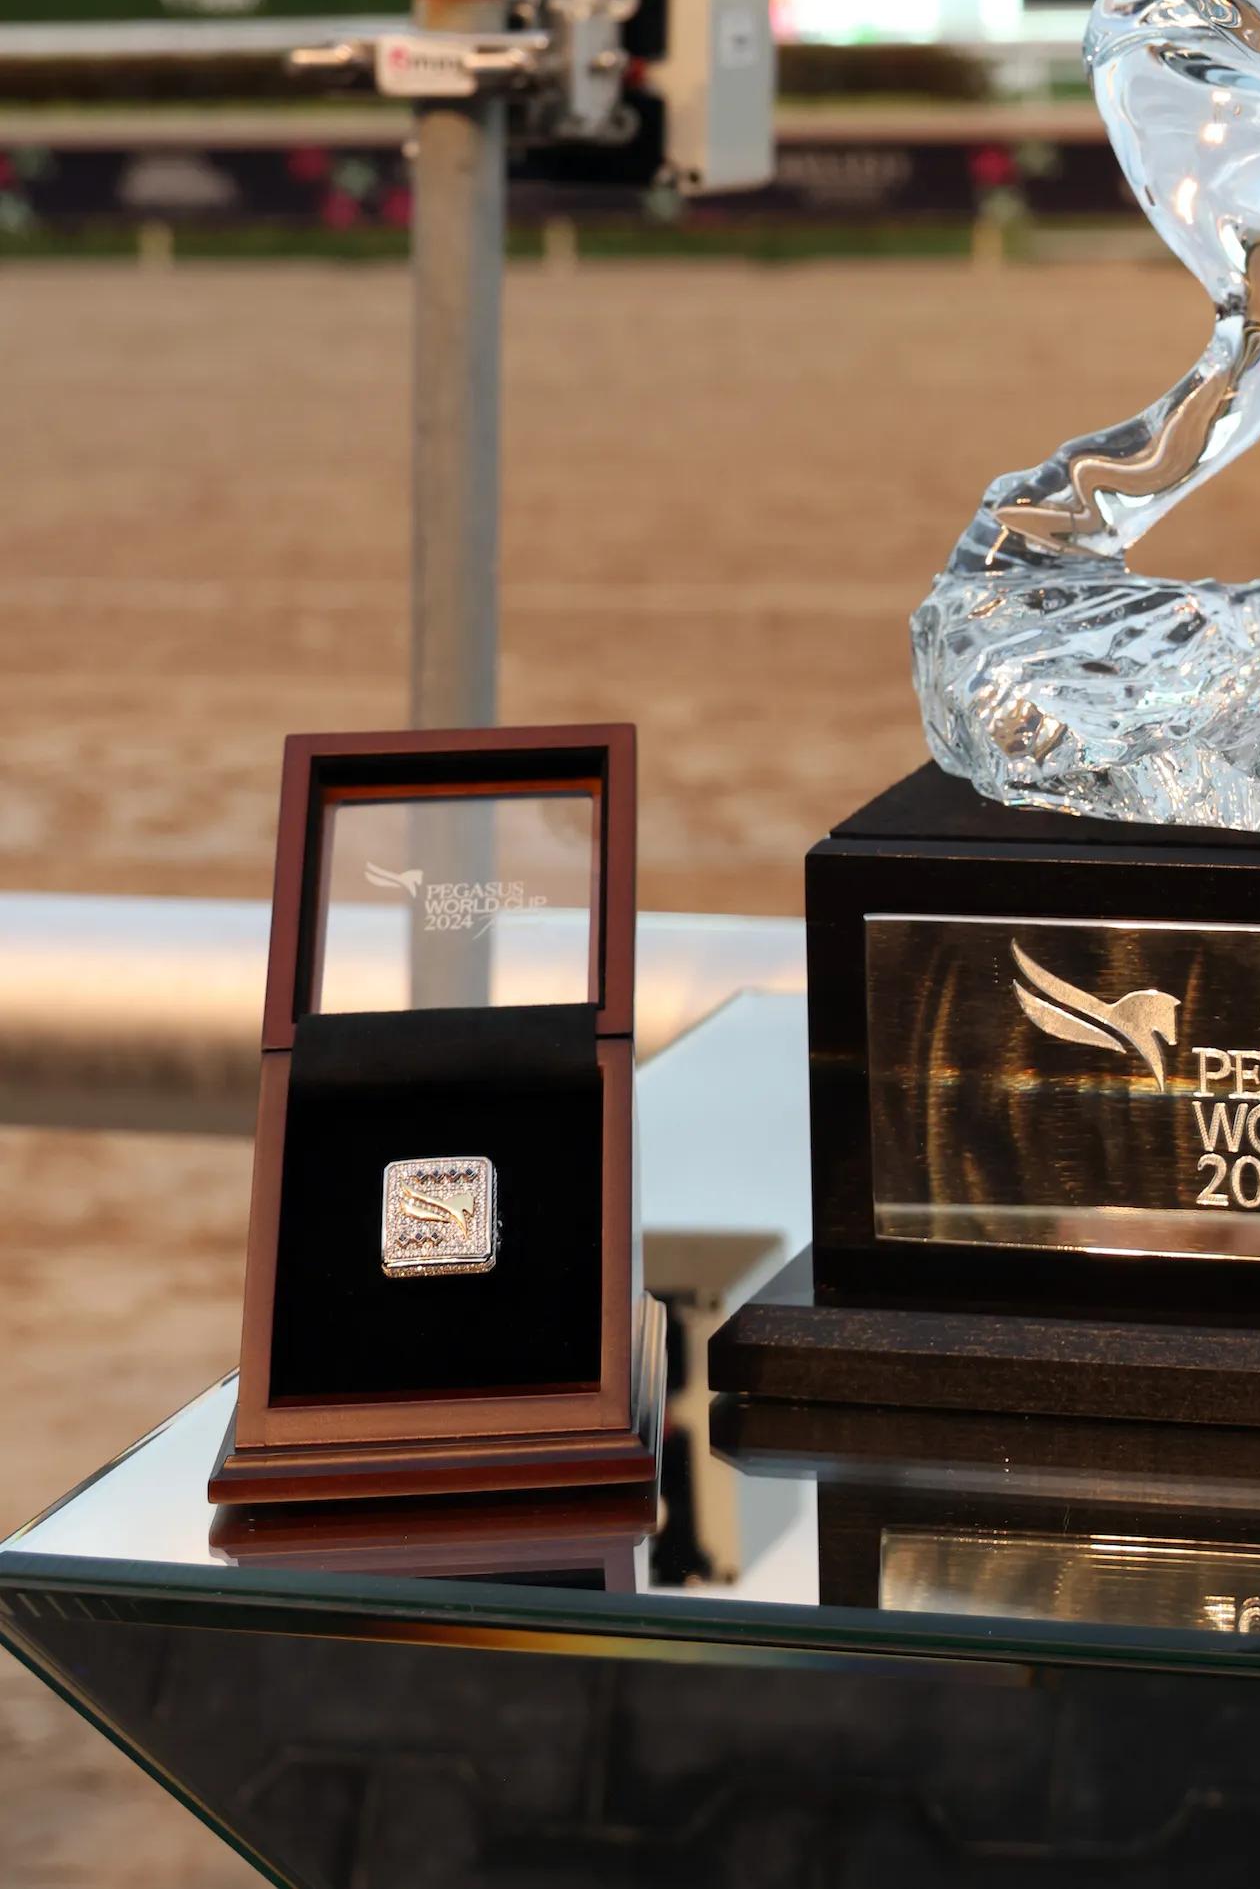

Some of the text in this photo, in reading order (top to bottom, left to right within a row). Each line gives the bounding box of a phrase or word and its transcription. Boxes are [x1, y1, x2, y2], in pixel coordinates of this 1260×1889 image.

[426, 881, 525, 900] PEGASUS
[424, 897, 499, 915] WORLD
[424, 913, 474, 931] 2024
